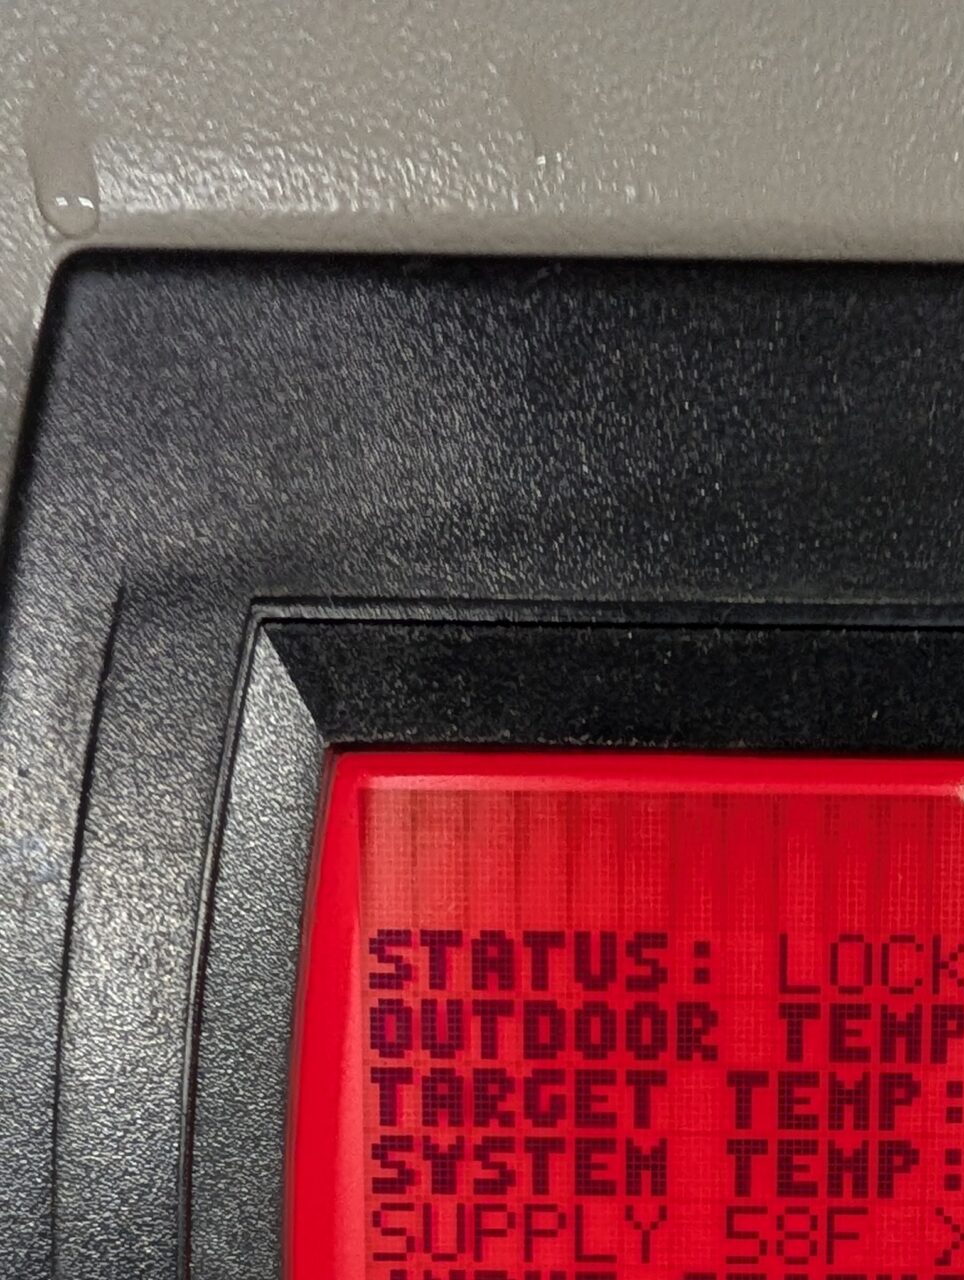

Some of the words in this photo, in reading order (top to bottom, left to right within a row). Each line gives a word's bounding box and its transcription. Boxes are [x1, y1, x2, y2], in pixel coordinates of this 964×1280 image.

[369, 929, 711, 992] STATUS:
[369, 999, 718, 1061] OUTDOOR
[370, 1066, 667, 1129] TARGET
[726, 1071, 963, 1131] TEMP:
[372, 1135, 667, 1197] SYSTEM
[726, 1139, 961, 1199] TEMP:
[372, 1203, 667, 1263] SUPPLY
[726, 1206, 868, 1264] 58F
